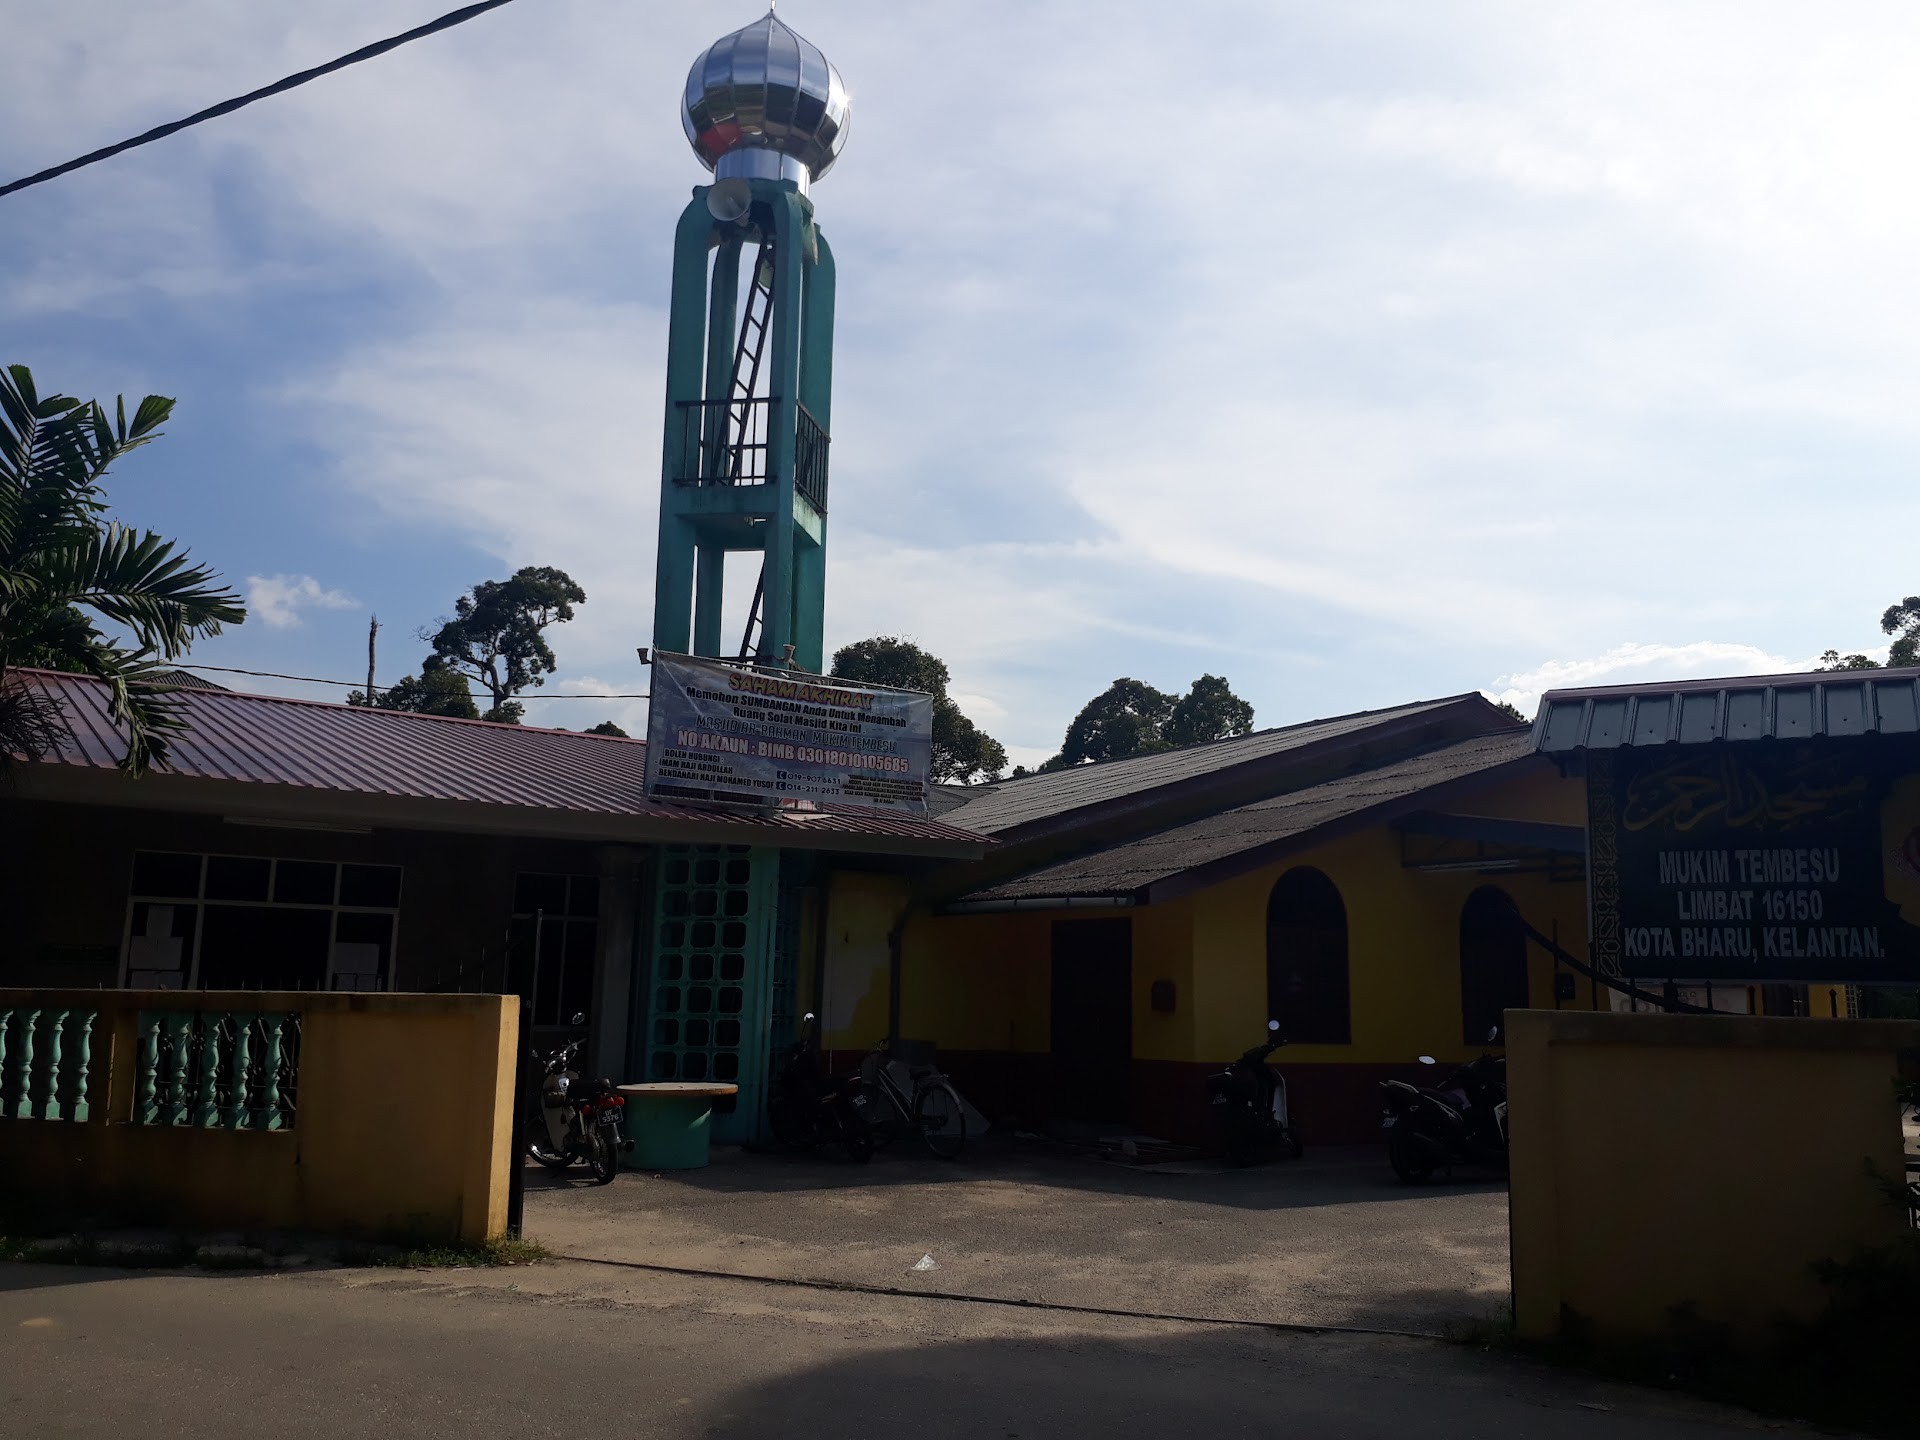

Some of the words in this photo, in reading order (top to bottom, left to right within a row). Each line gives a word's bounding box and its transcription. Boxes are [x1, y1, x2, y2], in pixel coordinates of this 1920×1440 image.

[686, 686, 738, 704] Memohon
[741, 695, 801, 713] SUMBANGAN
[803, 704, 826, 717] Anda
[829, 708, 855, 720] Untuk
[858, 712, 906, 727] Menambah
[730, 673, 797, 700] SAHAM
[797, 685, 874, 709] AKHIRAT
[733, 706, 765, 721] Ruang
[767, 711, 792, 724] Solat
[795, 715, 827, 730] Masjid
[829, 721, 847, 732] Kita
[678, 730, 698, 747] NO
[701, 732, 749, 754] AKAUN
[758, 741, 794, 760] BIMB
[740, 722, 806, 741] AR-RAHMAN
[811, 731, 848, 748] MUKIM
[852, 736, 897, 753] TEMBESU
[659, 758, 679, 767] IMAM
[680, 761, 696, 770] HAJI
[664, 748, 687, 759] BOLEH
[689, 752, 720, 763] HUBUNGI
[717, 775, 752, 787] MOHAMED
[753, 779, 774, 789] YUSOF
[1658, 850, 1730, 884] MUKIM
[1734, 848, 1840, 883] TEMBESU
[1677, 890, 1753, 920] LIMBAT
[1762, 889, 1823, 920] 16150
[1624, 927, 1675, 957] KOTA
[1680, 927, 1758, 964] BHARU,
[1763, 926, 1886, 958] KELANTAN.
